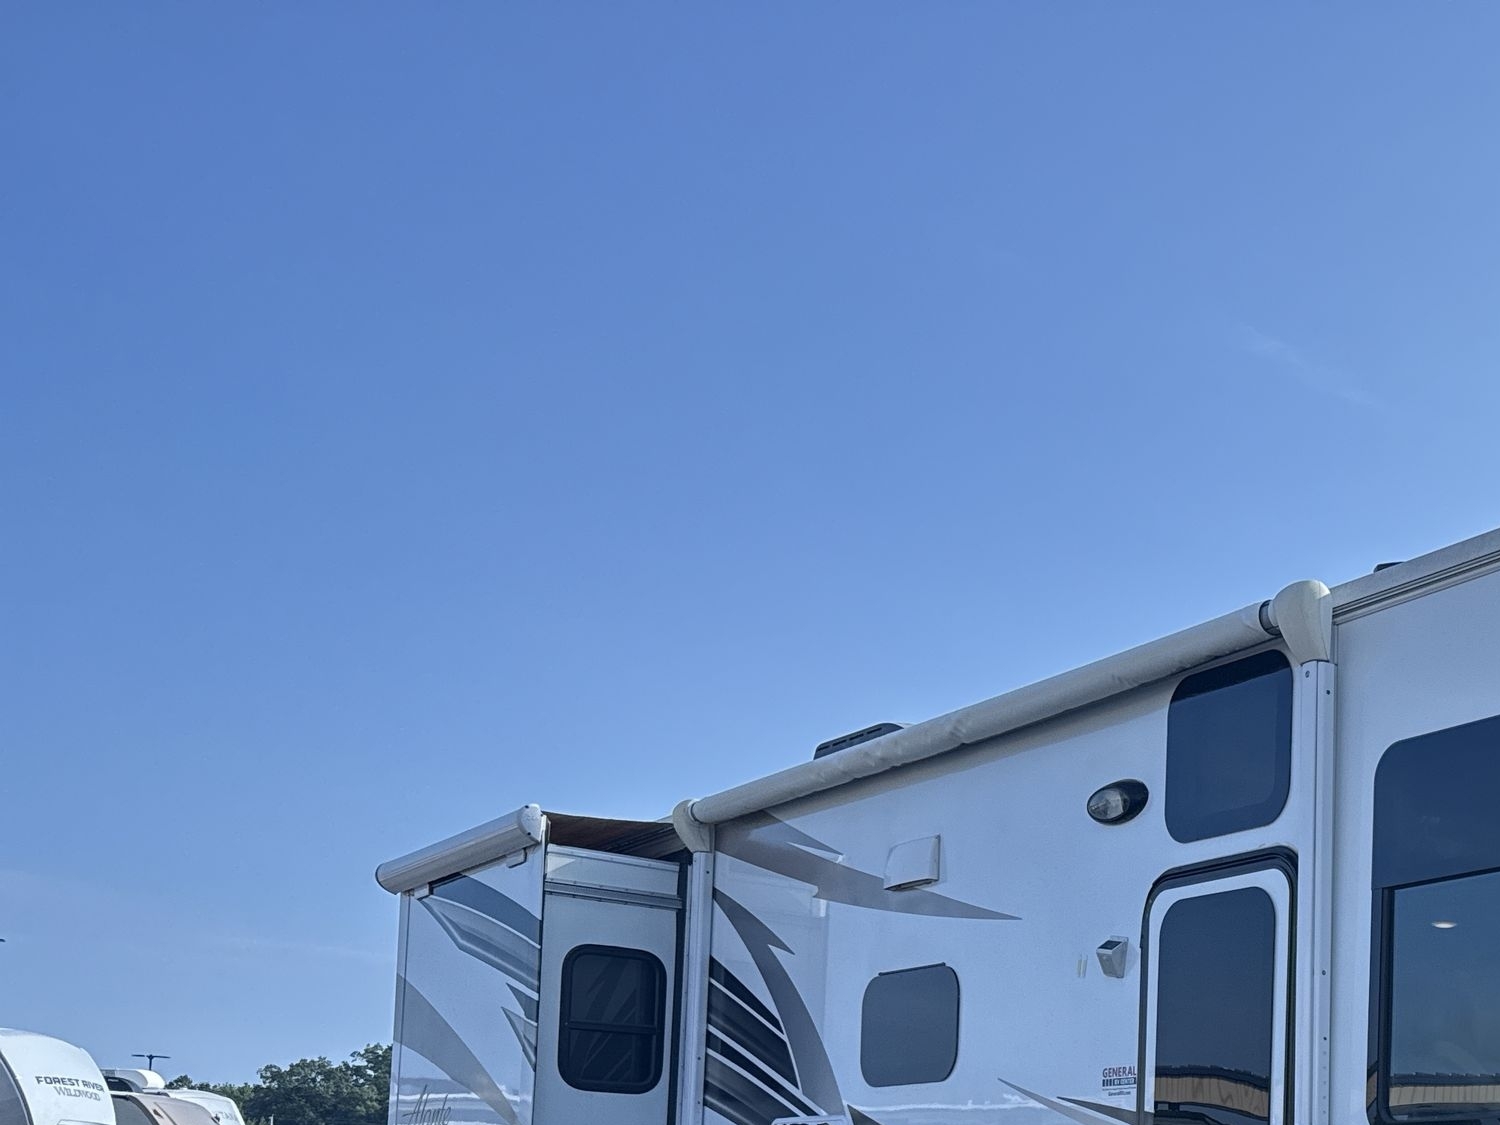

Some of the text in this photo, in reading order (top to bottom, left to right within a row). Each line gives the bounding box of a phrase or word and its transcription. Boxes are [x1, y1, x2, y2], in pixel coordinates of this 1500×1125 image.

[1102, 1066, 1137, 1079] GENERAL
[35, 1075, 105, 1093] FOREST RIVER
[53, 1086, 101, 1102] WILDWOOD
